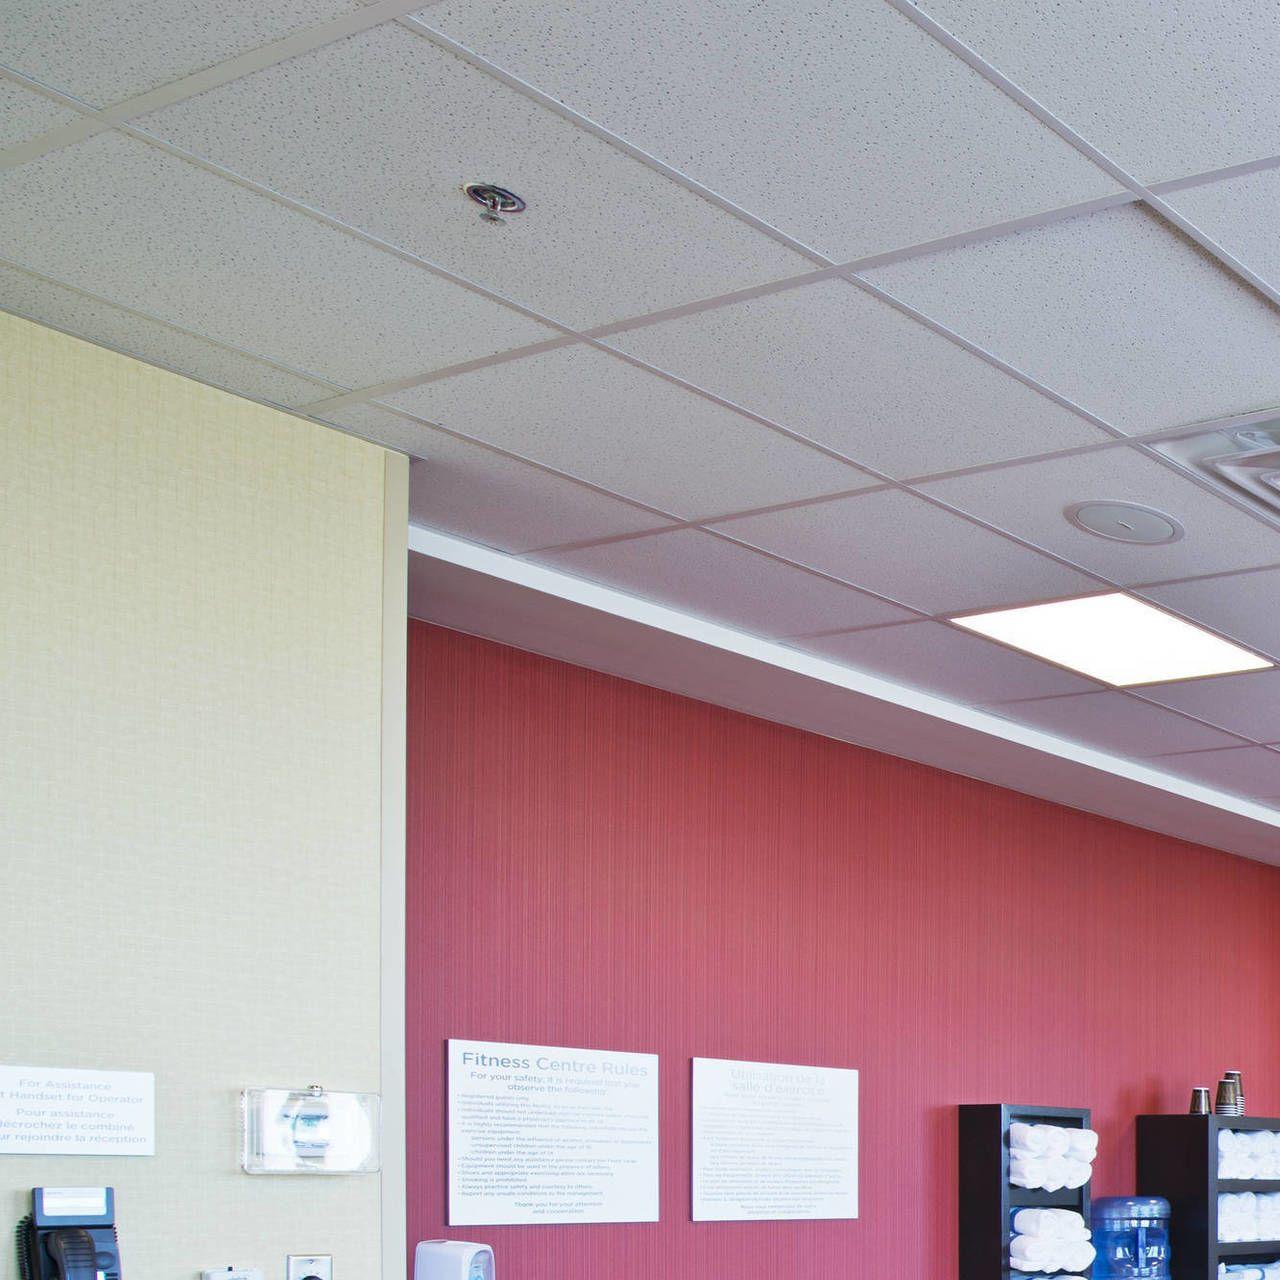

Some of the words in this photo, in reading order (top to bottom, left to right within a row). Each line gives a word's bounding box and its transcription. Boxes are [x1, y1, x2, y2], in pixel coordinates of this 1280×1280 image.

[462, 1052, 530, 1069] Fitness
[536, 1057, 597, 1073] Centre
[602, 1062, 648, 1077] Rules
[470, 1071, 487, 1080] For
[489, 1074, 511, 1083] your
[19, 1079, 41, 1088] For
[45, 1080, 112, 1091] Assistance
[507, 1083, 545, 1092] observe
[10, 1091, 63, 1102] Handset
[66, 1093, 84, 1102] for
[88, 1094, 144, 1105] Operator
[16, 1108, 46, 1117] Pour
[50, 1109, 115, 1119] assistance
[66, 1121, 77, 1130] le
[15, 1131, 72, 1144] rejoindre
[75, 1133, 86, 1143] la
